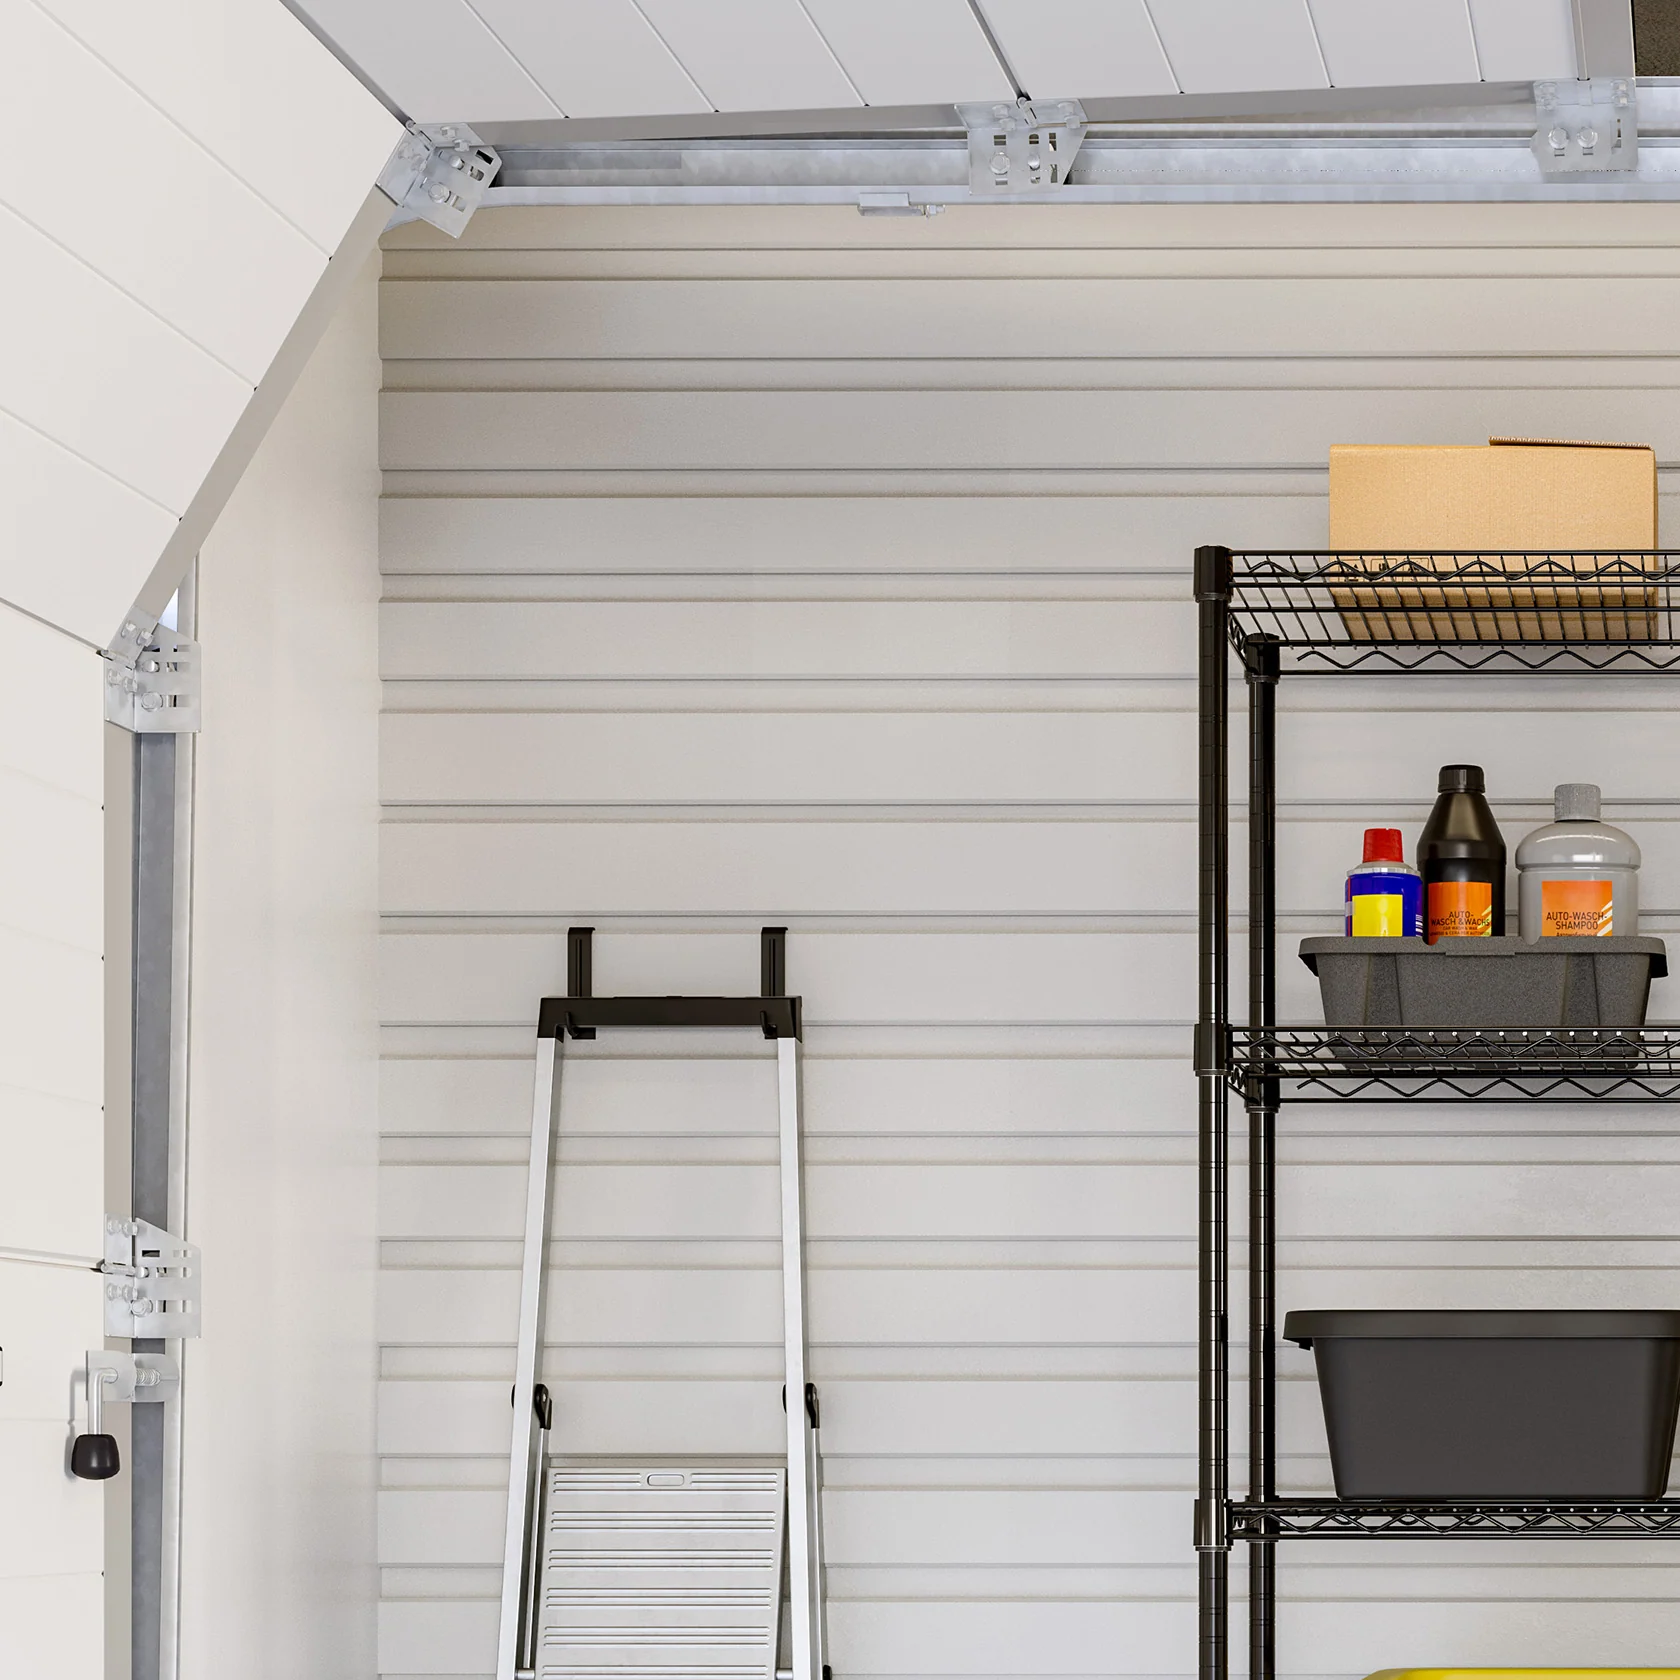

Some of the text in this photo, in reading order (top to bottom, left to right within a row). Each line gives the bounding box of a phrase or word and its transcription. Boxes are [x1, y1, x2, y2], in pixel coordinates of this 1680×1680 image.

[1546, 911, 1607, 921] AUTO-WASCH-
[1431, 918, 1456, 926] WASCH
[1555, 920, 1599, 930] SHAMPOO
